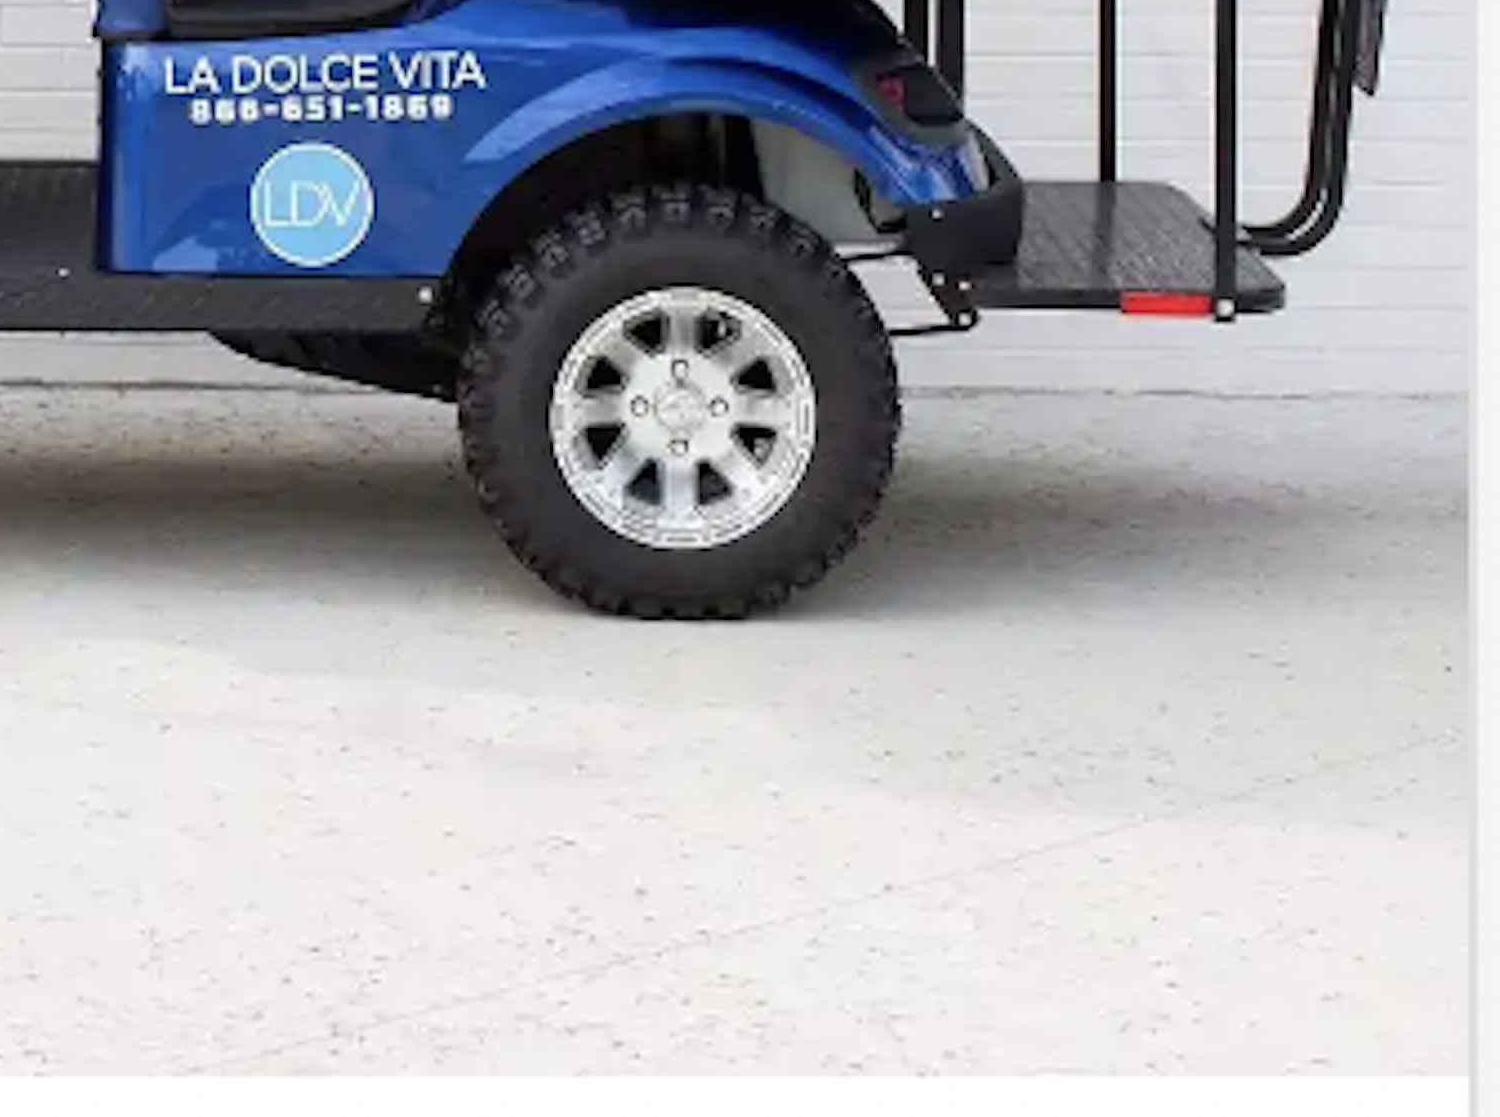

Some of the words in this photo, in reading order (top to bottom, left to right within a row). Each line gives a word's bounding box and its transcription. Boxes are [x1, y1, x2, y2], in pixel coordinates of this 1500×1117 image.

[164, 55, 221, 95] LA
[231, 53, 379, 93] DOLCE
[389, 49, 487, 90] VITA
[189, 93, 453, 125] 866-651-1869
[263, 179, 361, 228] LDV
